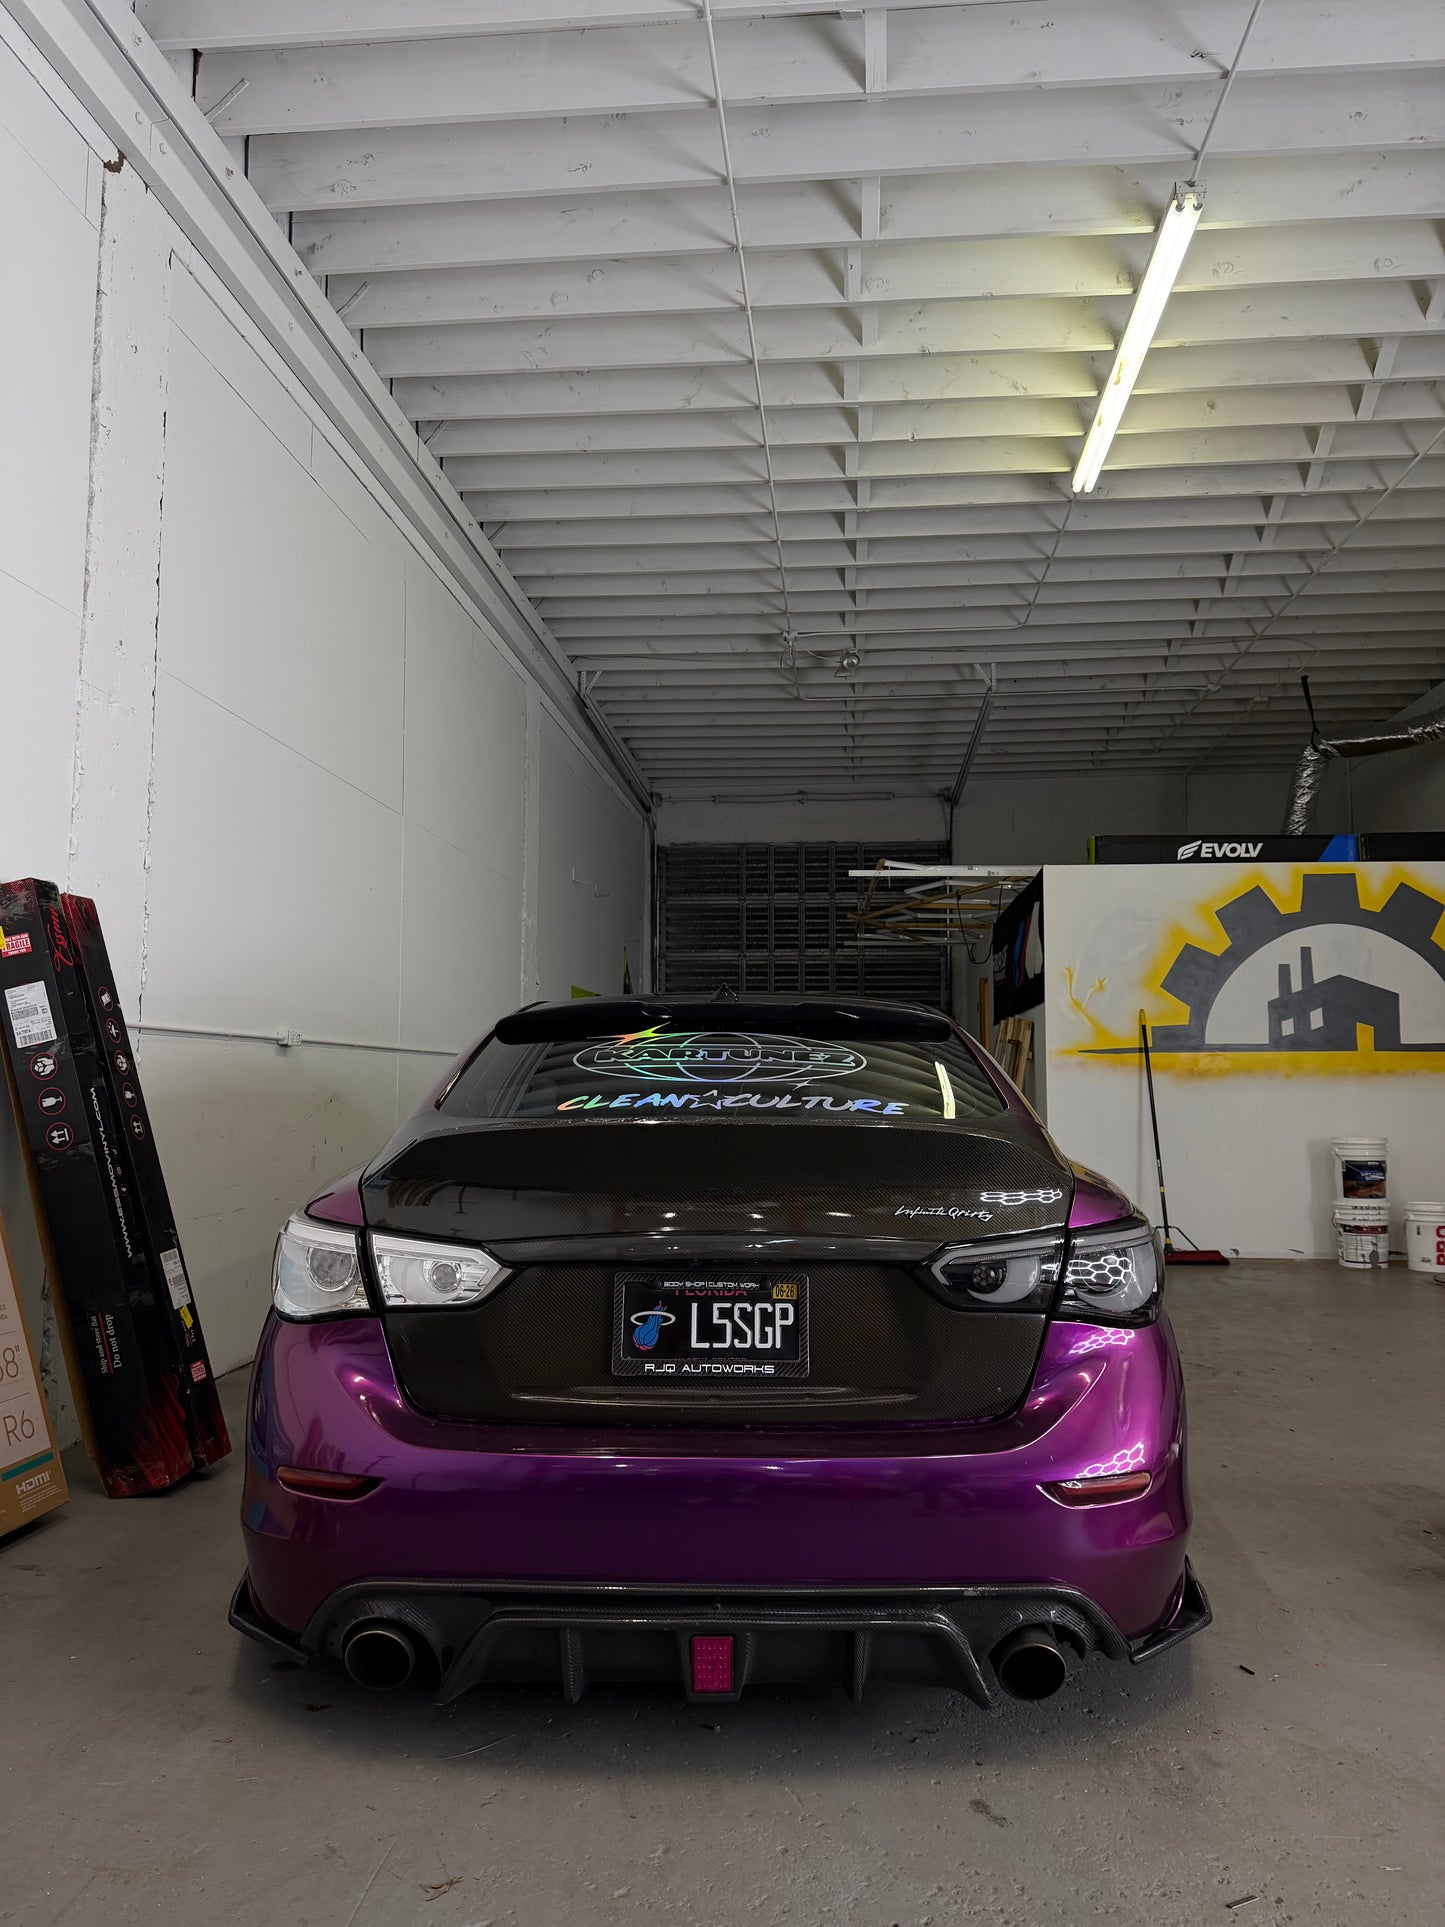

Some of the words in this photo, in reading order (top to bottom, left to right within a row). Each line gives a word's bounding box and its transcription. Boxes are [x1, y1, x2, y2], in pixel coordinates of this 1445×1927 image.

[1200, 842, 1263, 858] EVOLV
[3, 939, 29, 951] RAGILE
[593, 1048, 855, 1068] KARTUNEZ
[557, 1092, 690, 1111] CLEAN
[720, 1093, 910, 1115] CULTURE
[90, 1087, 133, 1258] WWW.ESSMOVINYL.COM
[104, 1314, 115, 1336] drop
[691, 1303, 794, 1349] L5SGP
[108, 1337, 119, 1352] not
[112, 1353, 122, 1369] Do
[644, 1363, 676, 1374] RJQ
[682, 1363, 775, 1374] AUTOWORKS
[3, 1410, 35, 1446] R6
[15, 1471, 51, 1496] HDMI
